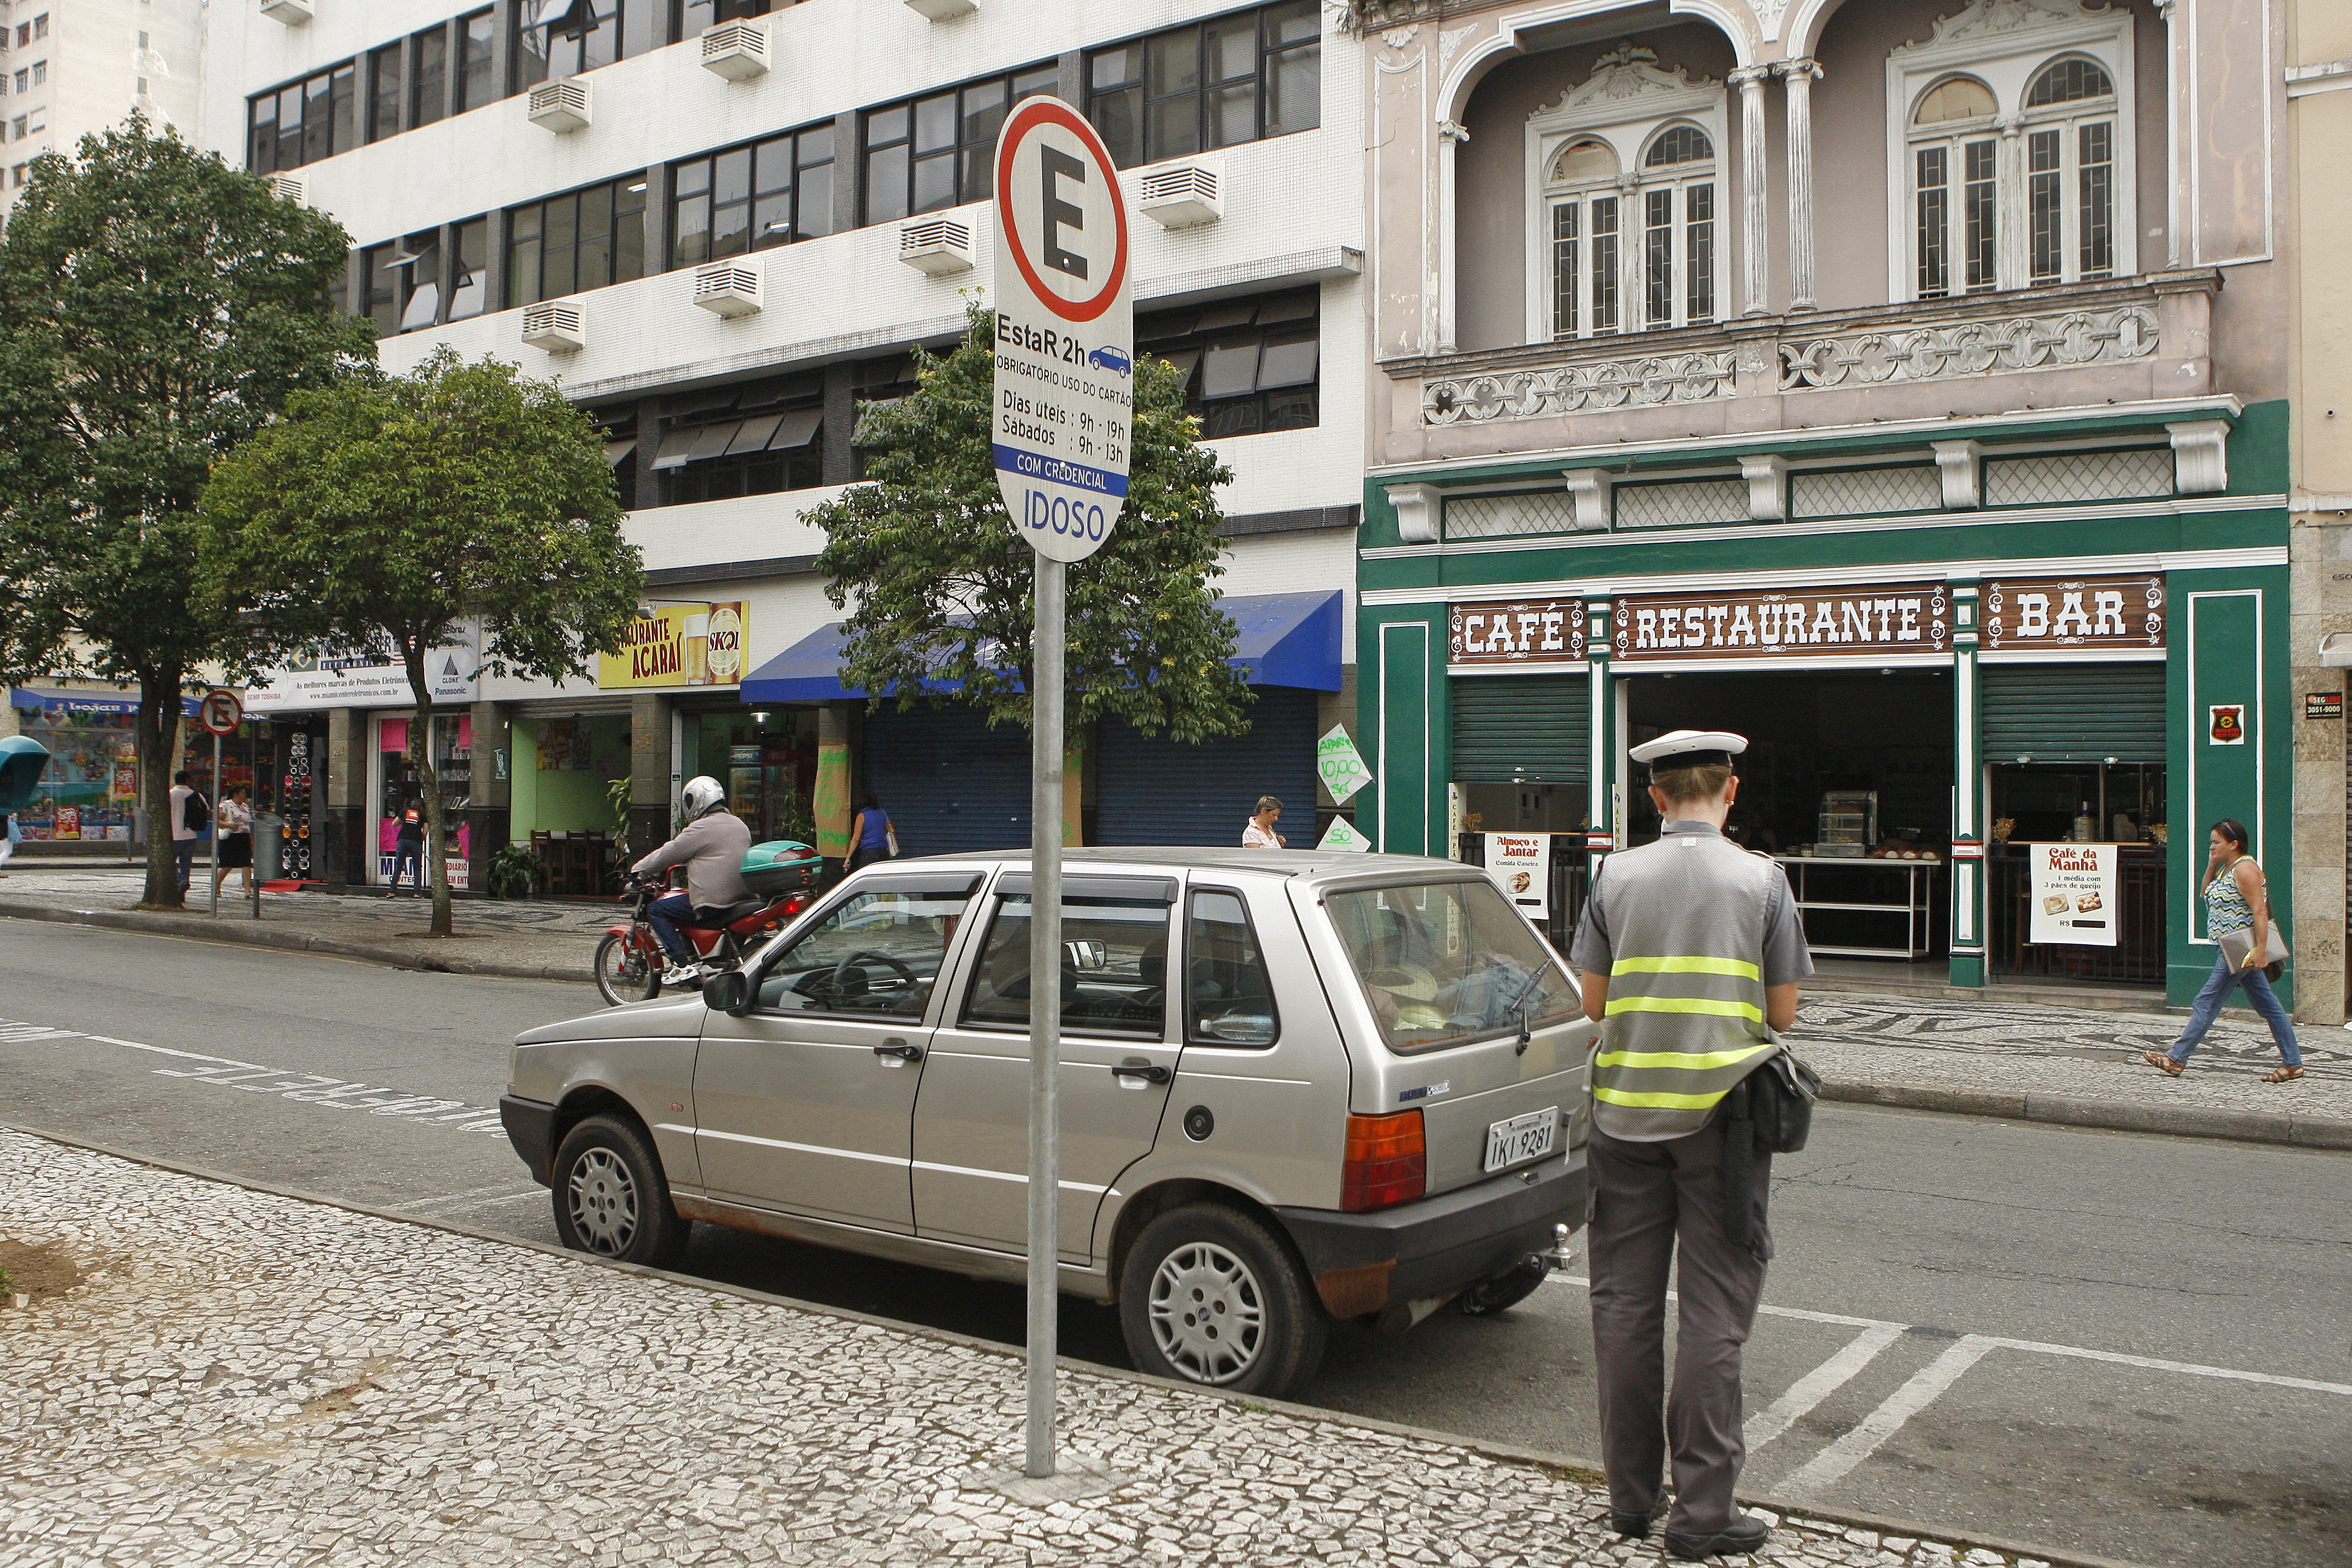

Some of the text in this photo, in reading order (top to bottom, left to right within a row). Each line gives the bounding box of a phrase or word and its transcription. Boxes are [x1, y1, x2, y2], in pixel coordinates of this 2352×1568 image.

[1040, 143, 1088, 281] E
[998, 313, 1086, 367] EstaR 2h
[996, 354, 1132, 408] OBRIGATÓRIO USO DO CARTÃO
[1004, 390, 1031, 414] Dias
[1036, 400, 1066, 425] úteis
[1080, 413, 1094, 433] 9h
[1106, 420, 1125, 441] 19h
[1002, 415, 1056, 445] Sábados
[1079, 436, 1094, 456] 9h
[1106, 443, 1123, 464] 13h
[1017, 454, 1042, 475] COM
[1025, 489, 1104, 541] IDOSO
[1465, 603, 1563, 653] CAFÉ
[1636, 598, 1922, 649] RESTAURANTE
[2016, 591, 2126, 637] BAR
[632, 632, 682, 679] ACARAÍ
[708, 630, 740, 652] SKOL
[304, 681, 327, 689] melhores
[356, 677, 381, 686] Produtos
[382, 676, 411, 685] Eletrônico
[435, 687, 466, 695] Panasonic
[68, 702, 121, 712] Lojas
[1496, 836, 1530, 848] Almoço
[1503, 846, 1539, 857] Jantar
[2048, 848, 2097, 858] Café da
[446, 860, 468, 871] EDIÁRIO
[2048, 858, 2099, 871] Manhã
